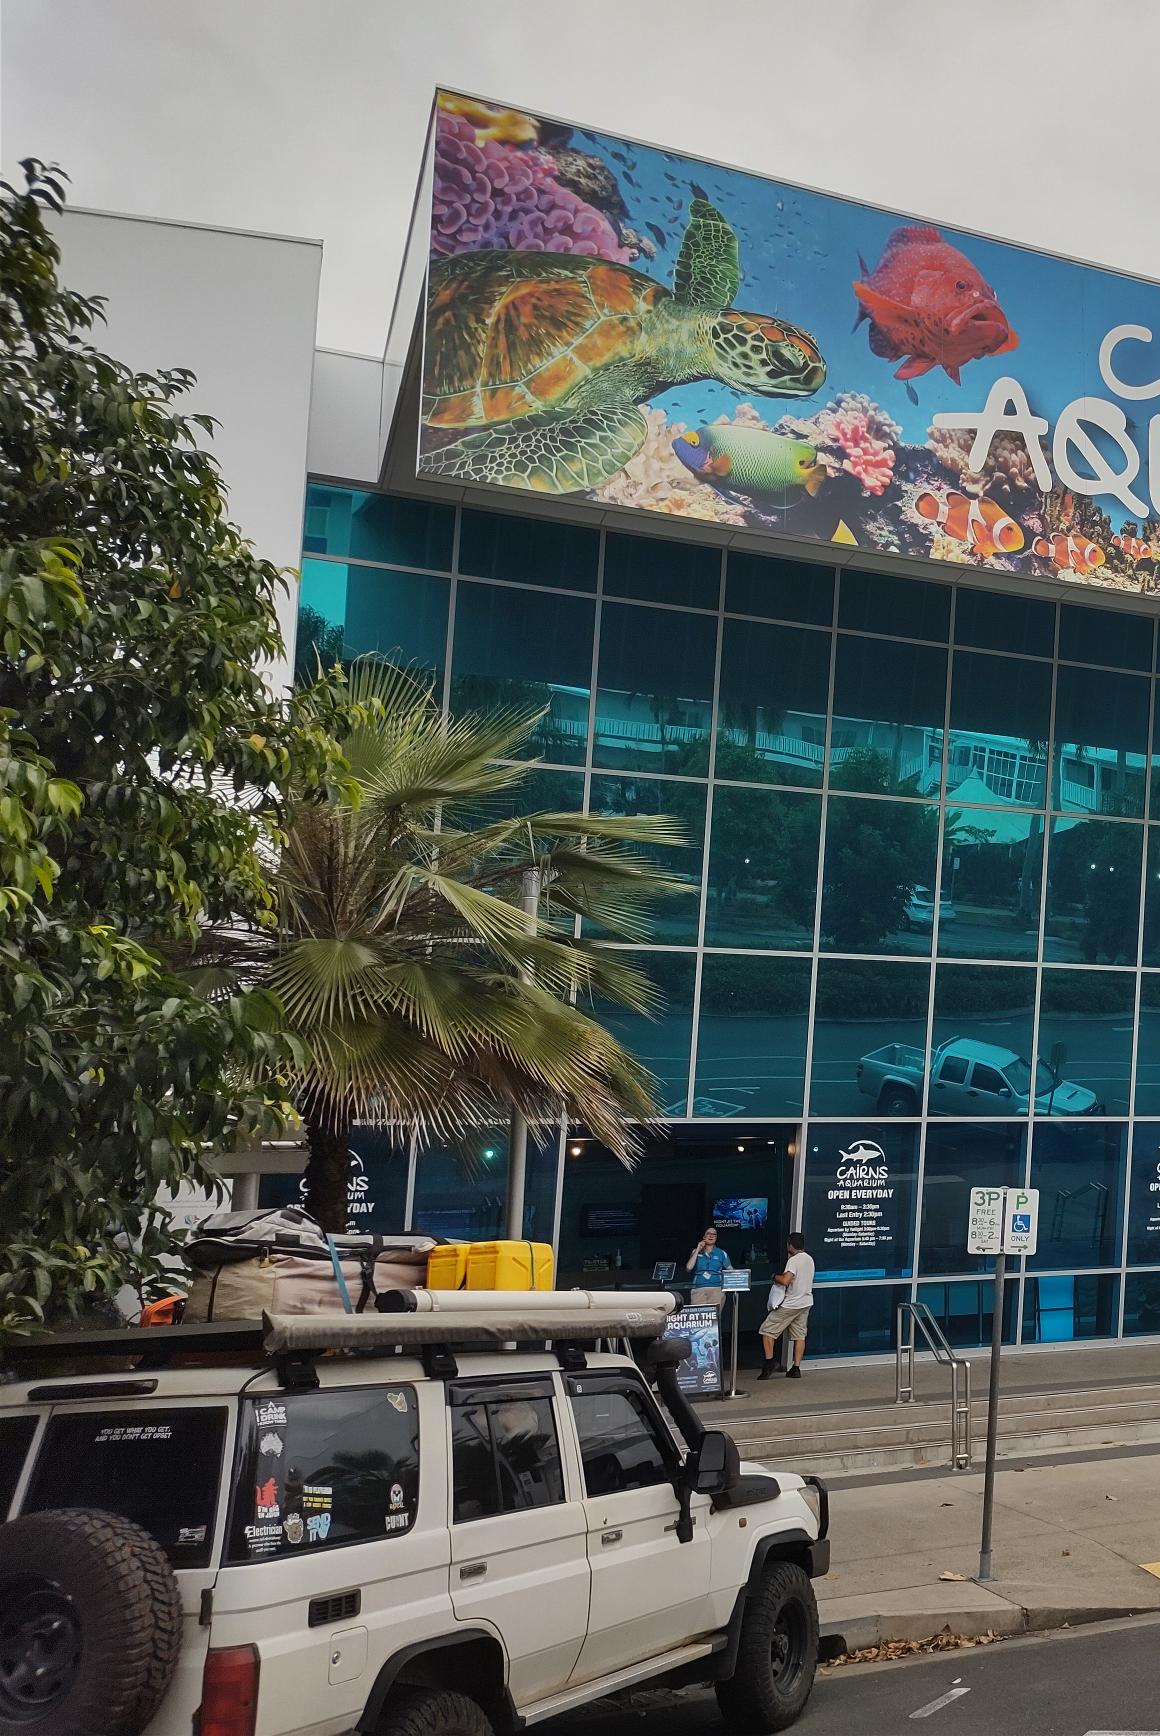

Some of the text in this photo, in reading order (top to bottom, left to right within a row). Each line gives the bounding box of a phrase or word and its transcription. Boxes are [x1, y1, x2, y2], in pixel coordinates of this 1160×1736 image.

[837, 1179, 886, 1188] AQUARIUM
[828, 1189, 894, 1199] OPEN EVERYDAY
[974, 1190, 1029, 1210] 3P P
[848, 1211, 862, 1219] Entry
[666, 1314, 688, 1323] IGHT
[689, 1313, 700, 1321] AT
[701, 1311, 717, 1320] THE
[667, 1320, 713, 1330] AQUARIUM
[260, 1413, 287, 1421] DRINK
[244, 1523, 283, 1539] Electrician
